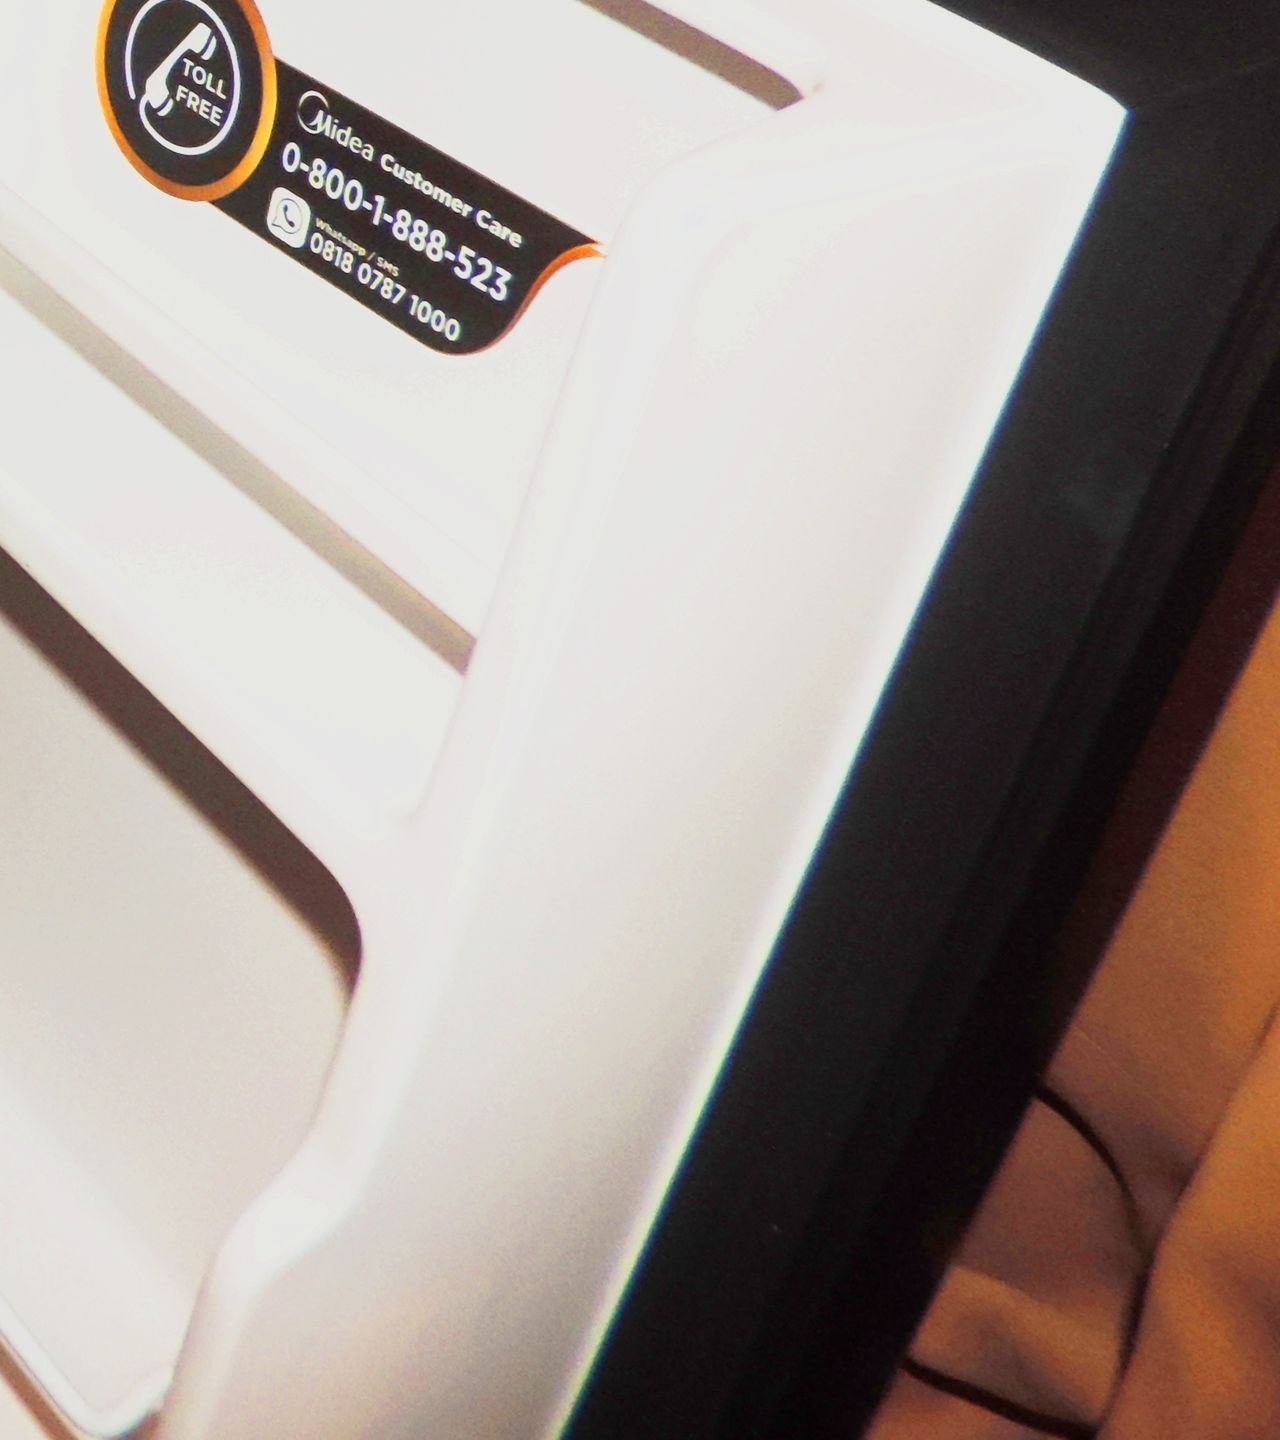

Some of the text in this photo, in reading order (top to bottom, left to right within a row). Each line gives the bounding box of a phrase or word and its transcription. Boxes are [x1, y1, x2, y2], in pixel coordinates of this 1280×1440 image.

[175, 84, 224, 127] FREE
[181, 57, 227, 101] TOLL
[297, 90, 523, 248] Midea Customer Care
[281, 141, 513, 302] 0-800-1-888-523
[309, 231, 462, 341] 0818 0787 1000
[376, 256, 400, 277] SMS
